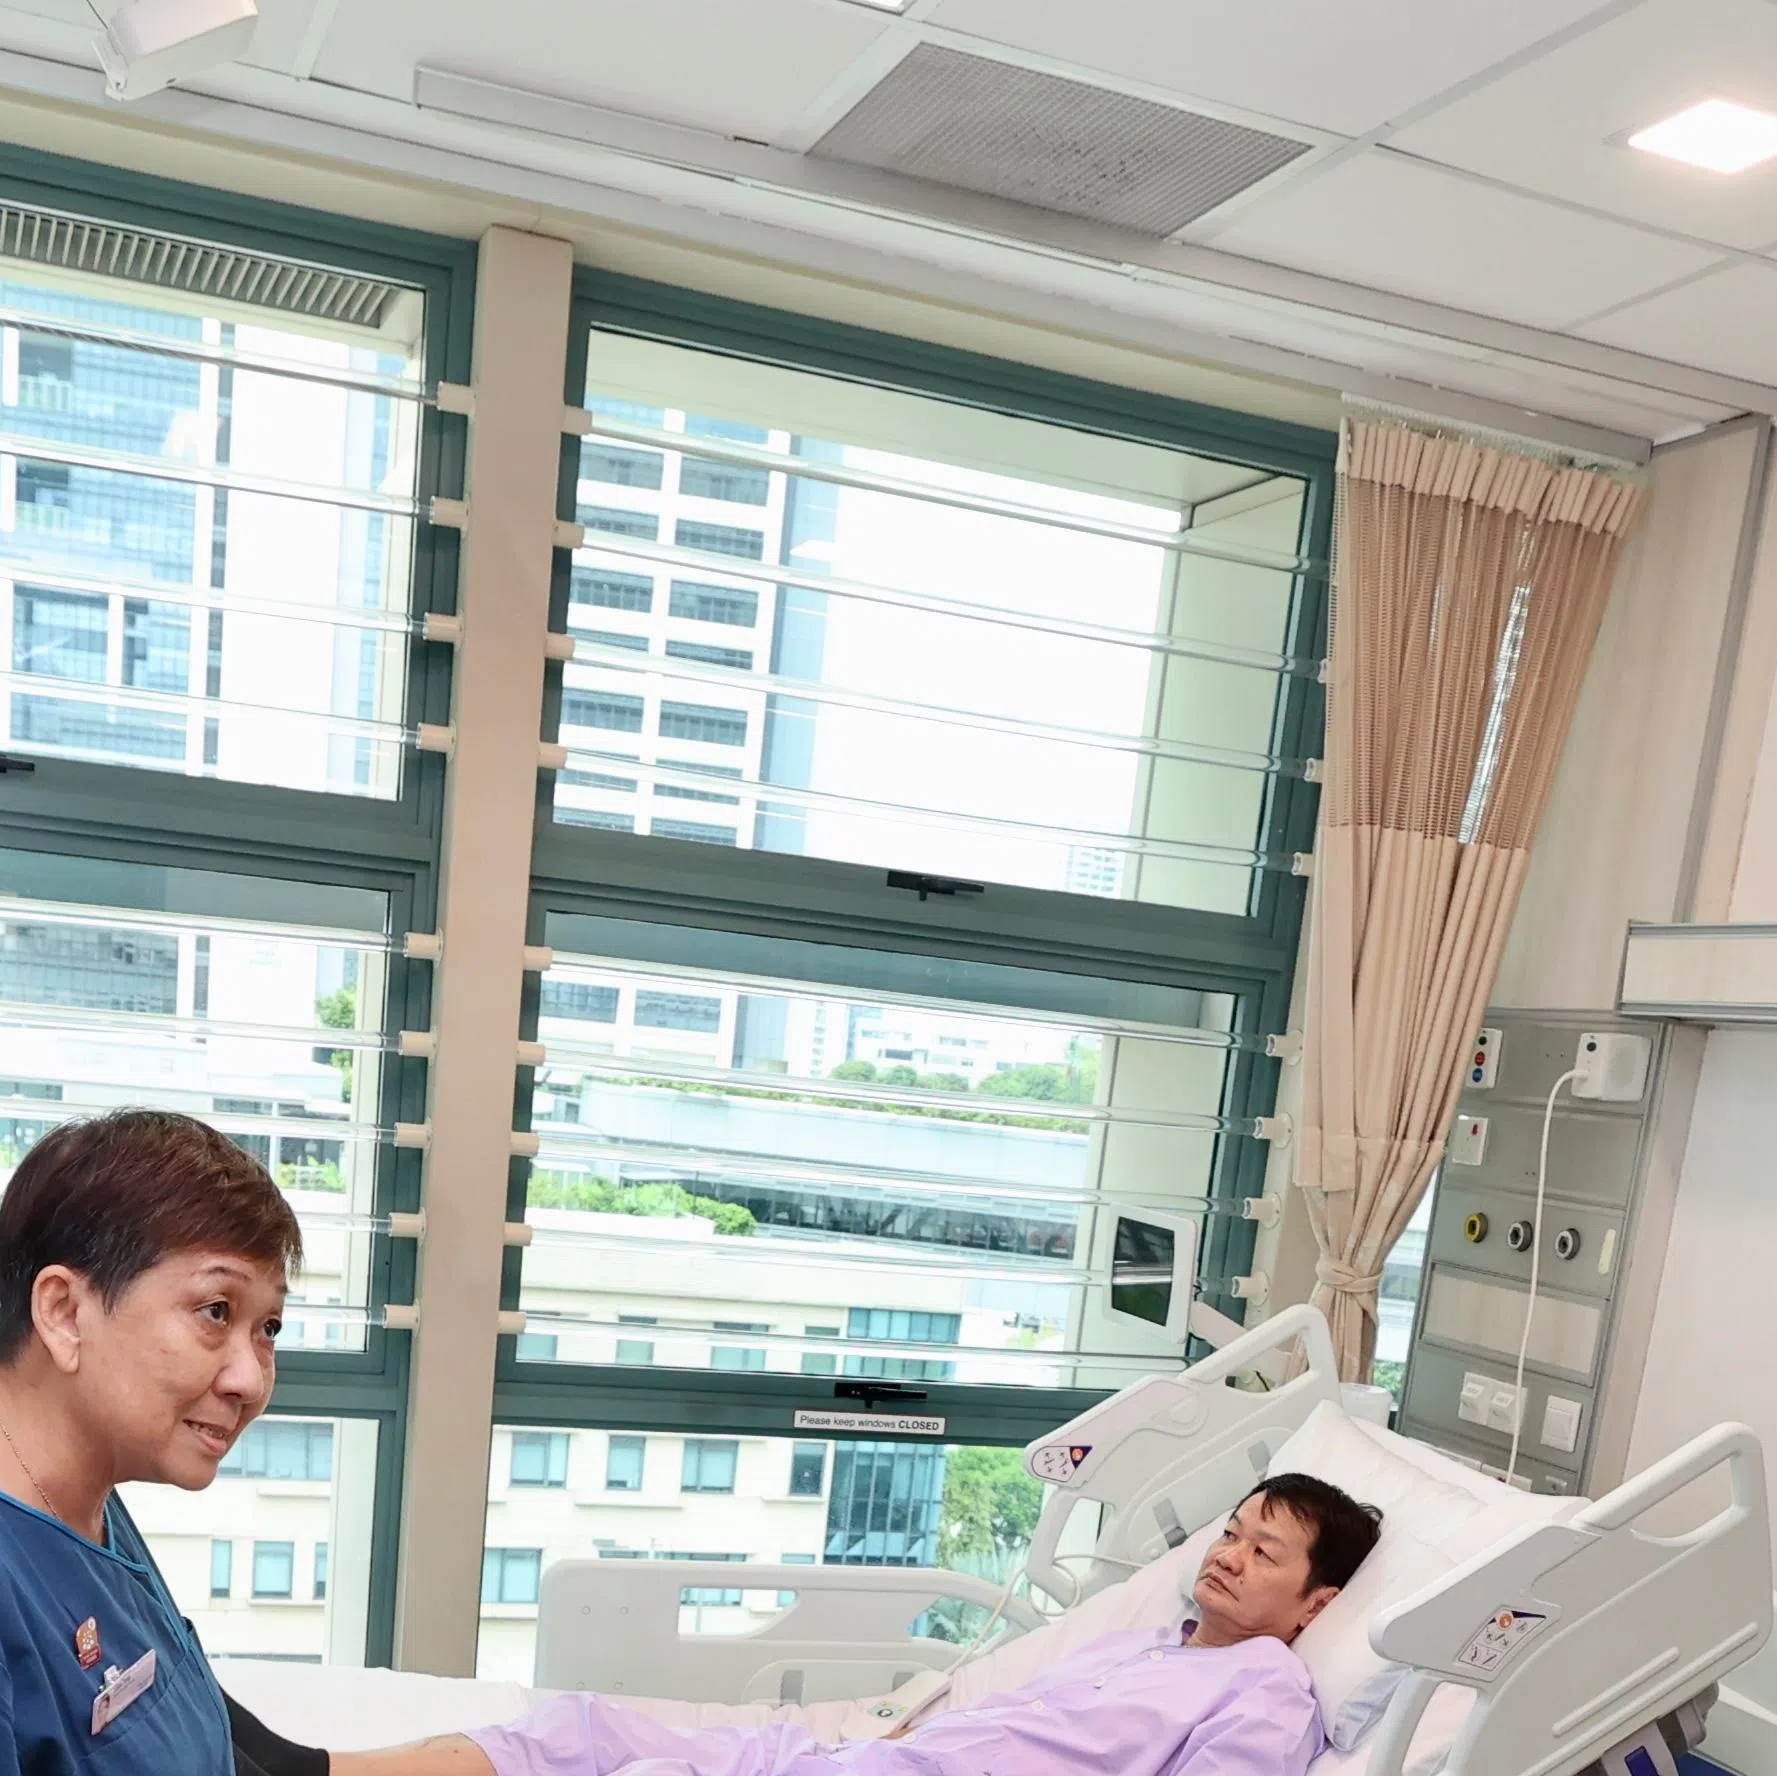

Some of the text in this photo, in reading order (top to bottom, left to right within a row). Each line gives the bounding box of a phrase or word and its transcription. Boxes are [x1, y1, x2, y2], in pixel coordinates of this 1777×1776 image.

[800, 1415, 940, 1431] Please keep windows CLOSED
